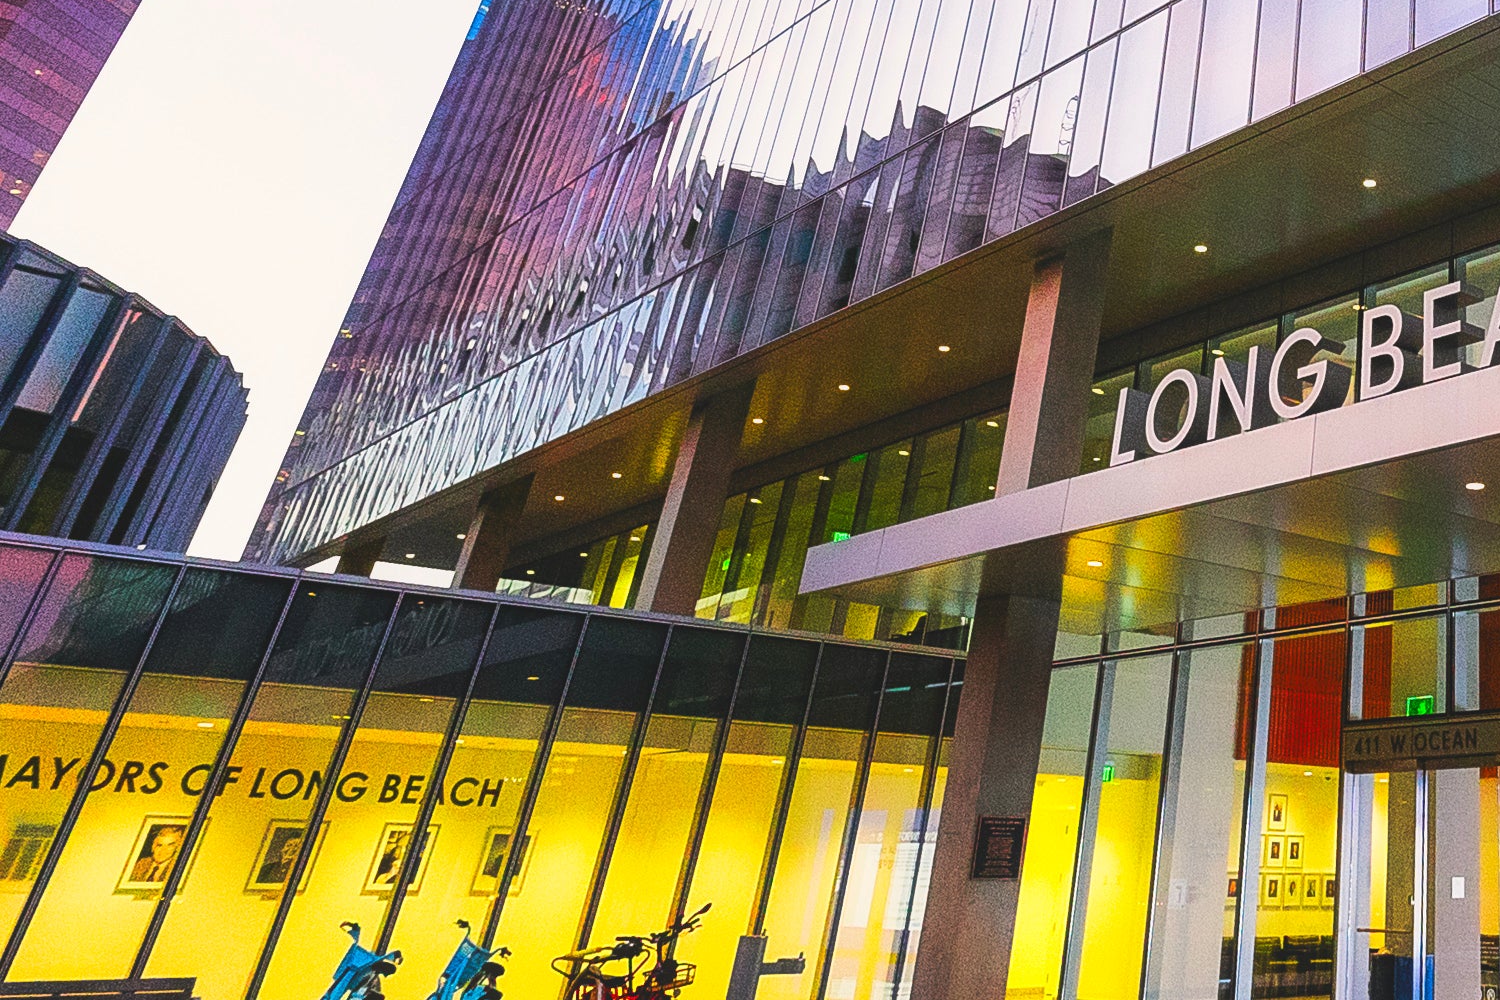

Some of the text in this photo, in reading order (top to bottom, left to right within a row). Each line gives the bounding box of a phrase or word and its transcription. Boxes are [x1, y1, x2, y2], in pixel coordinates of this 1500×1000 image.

[1109, 328, 1345, 467] LONG
[1354, 727, 1478, 754] 411 W OCEAN
[0, 754, 170, 794] AYORS
[181, 763, 243, 797] OF
